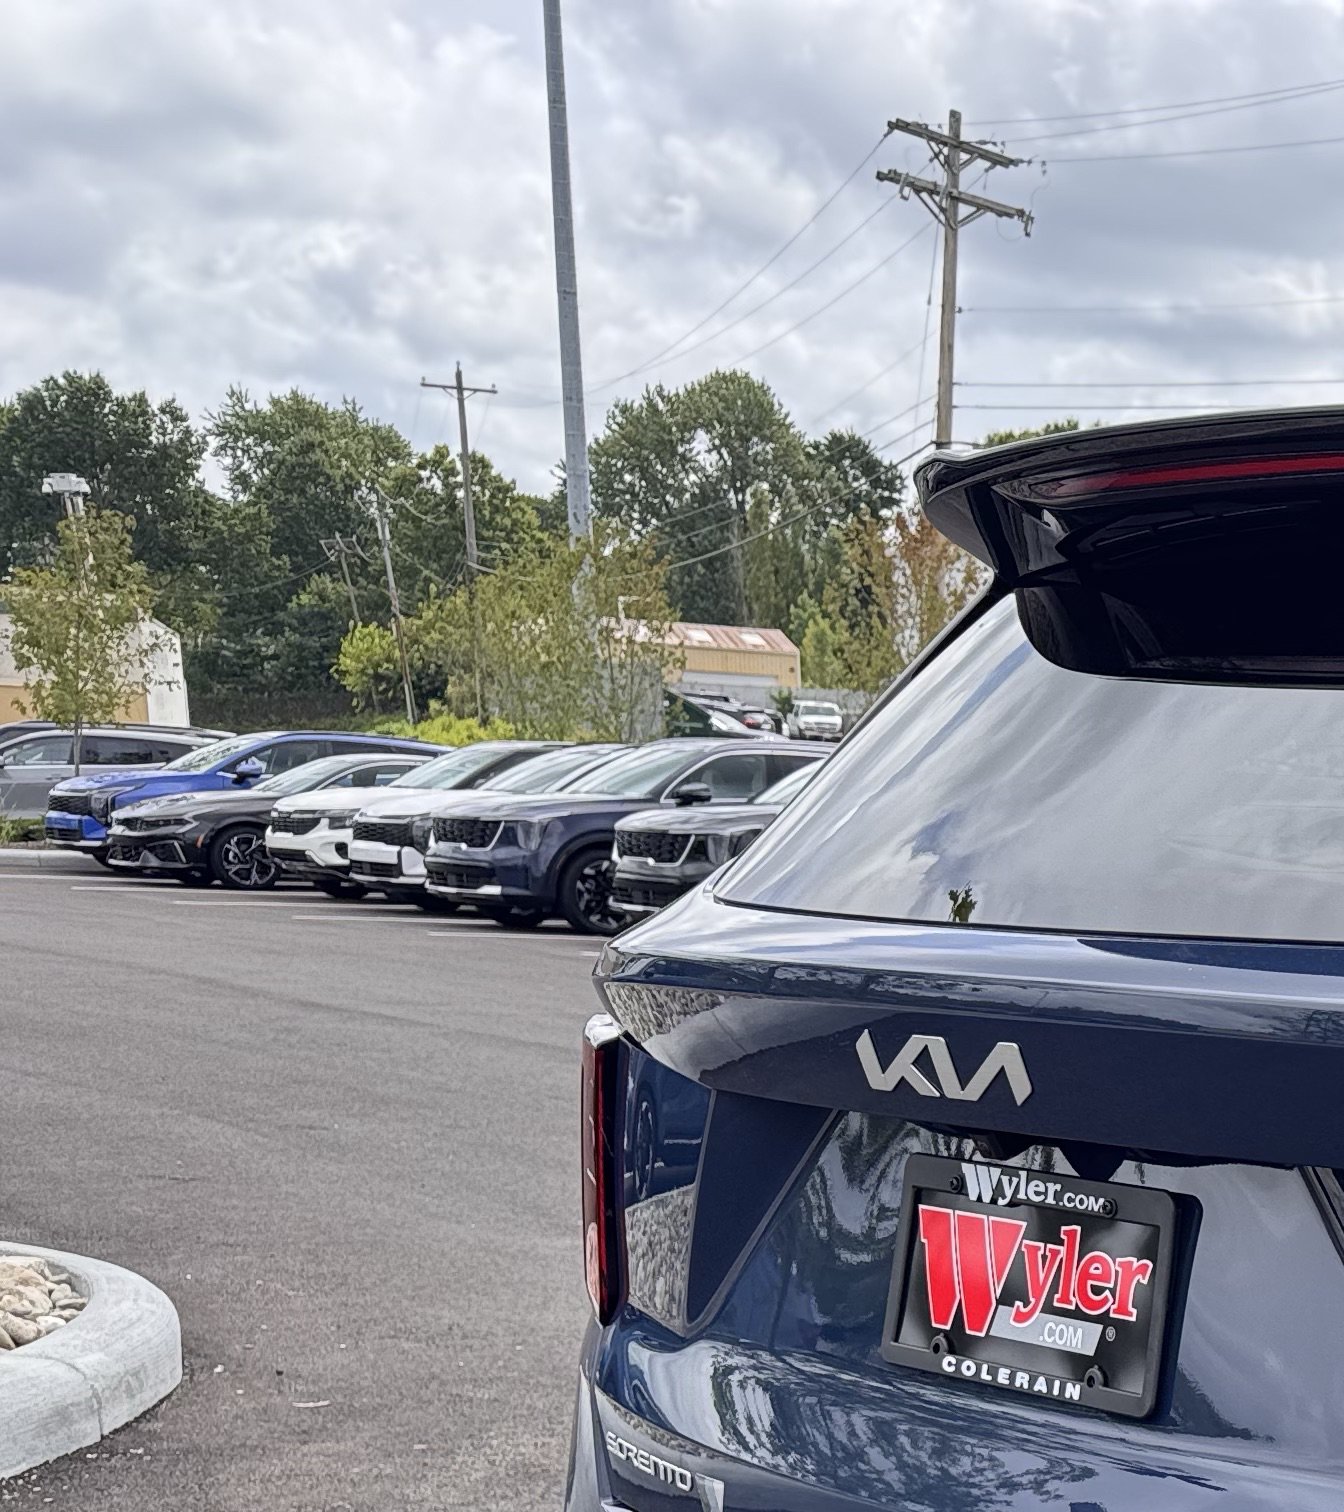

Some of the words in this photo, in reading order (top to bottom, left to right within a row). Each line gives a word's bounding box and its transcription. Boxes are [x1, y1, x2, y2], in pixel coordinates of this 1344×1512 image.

[856, 1029, 1033, 1106] KIA
[918, 1204, 1153, 1338] Wyler
[1039, 1321, 1084, 1348] .COM
[942, 1355, 1082, 1400] COLERAIN
[606, 1431, 692, 1492] SORENTO
